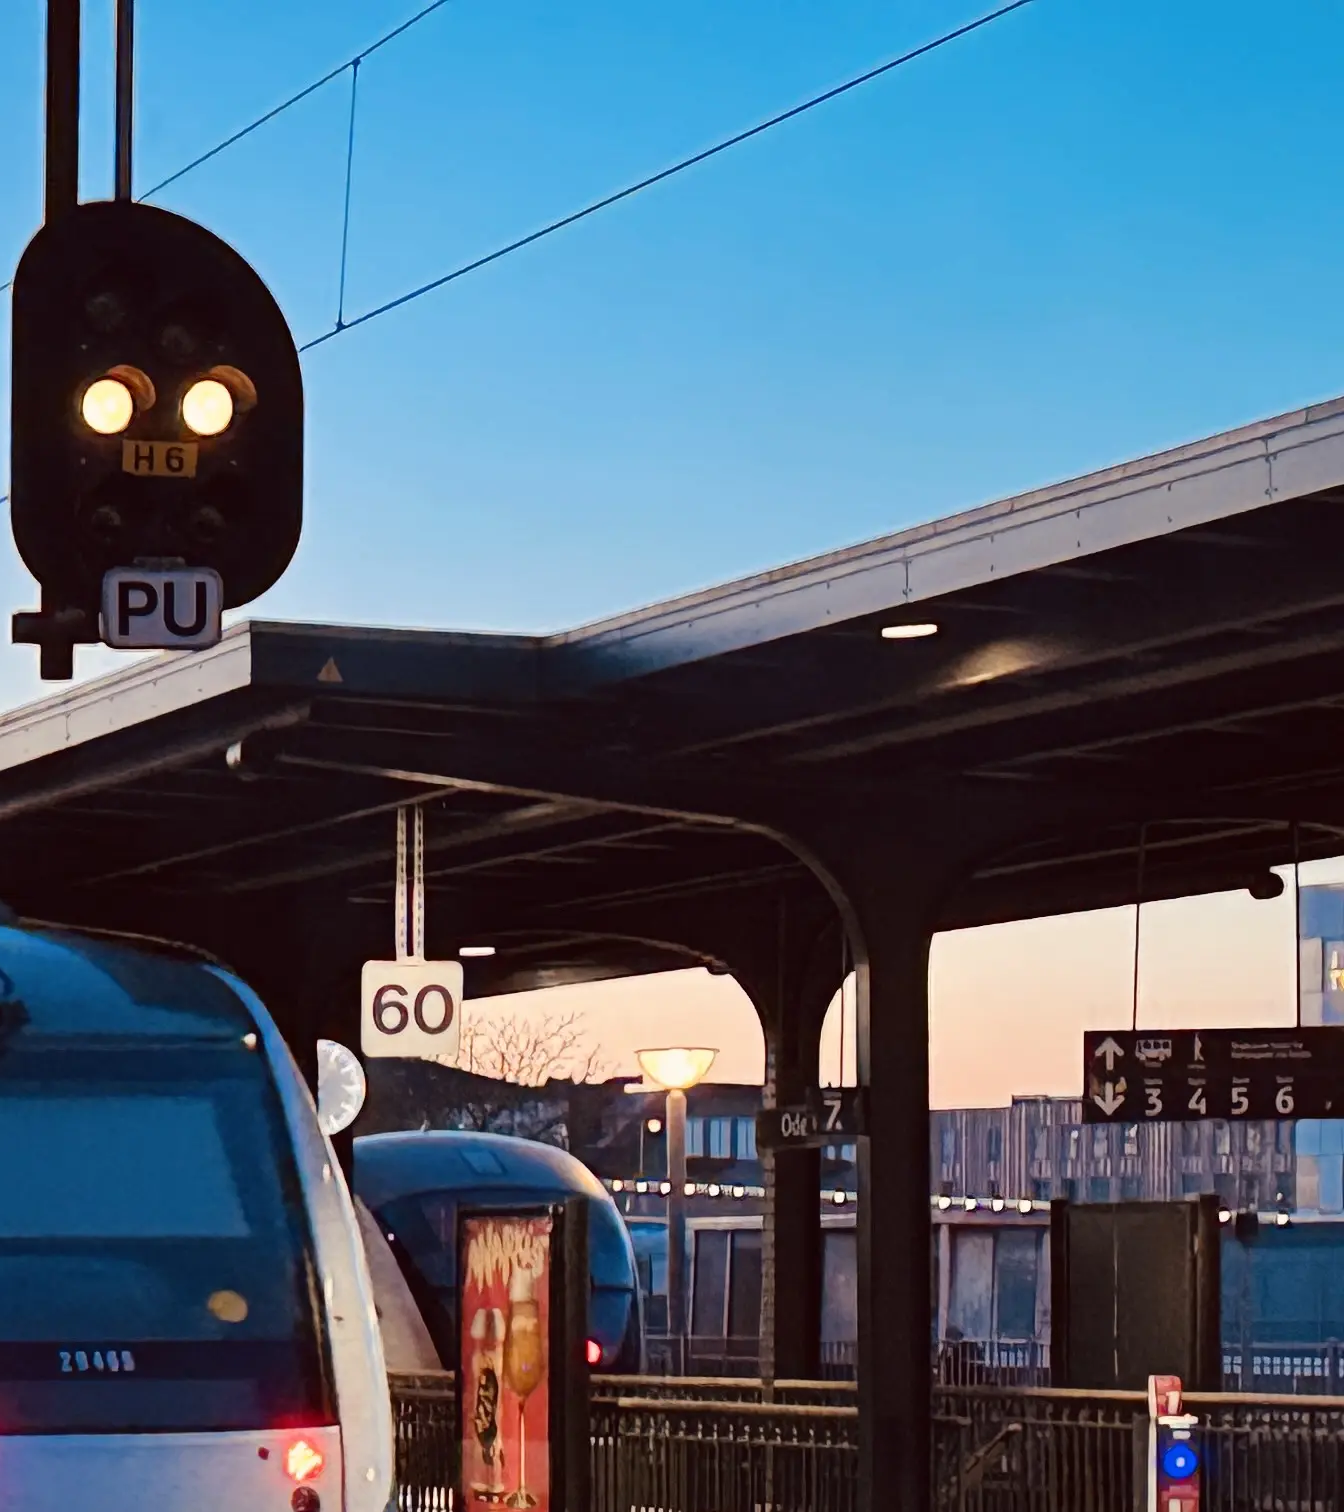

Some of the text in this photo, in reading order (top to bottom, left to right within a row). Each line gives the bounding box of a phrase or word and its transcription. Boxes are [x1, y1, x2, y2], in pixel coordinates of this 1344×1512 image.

[116, 580, 208, 638] PU
[371, 983, 455, 1036] 60
[1144, 1085, 1295, 1116] 3 4 5 6
